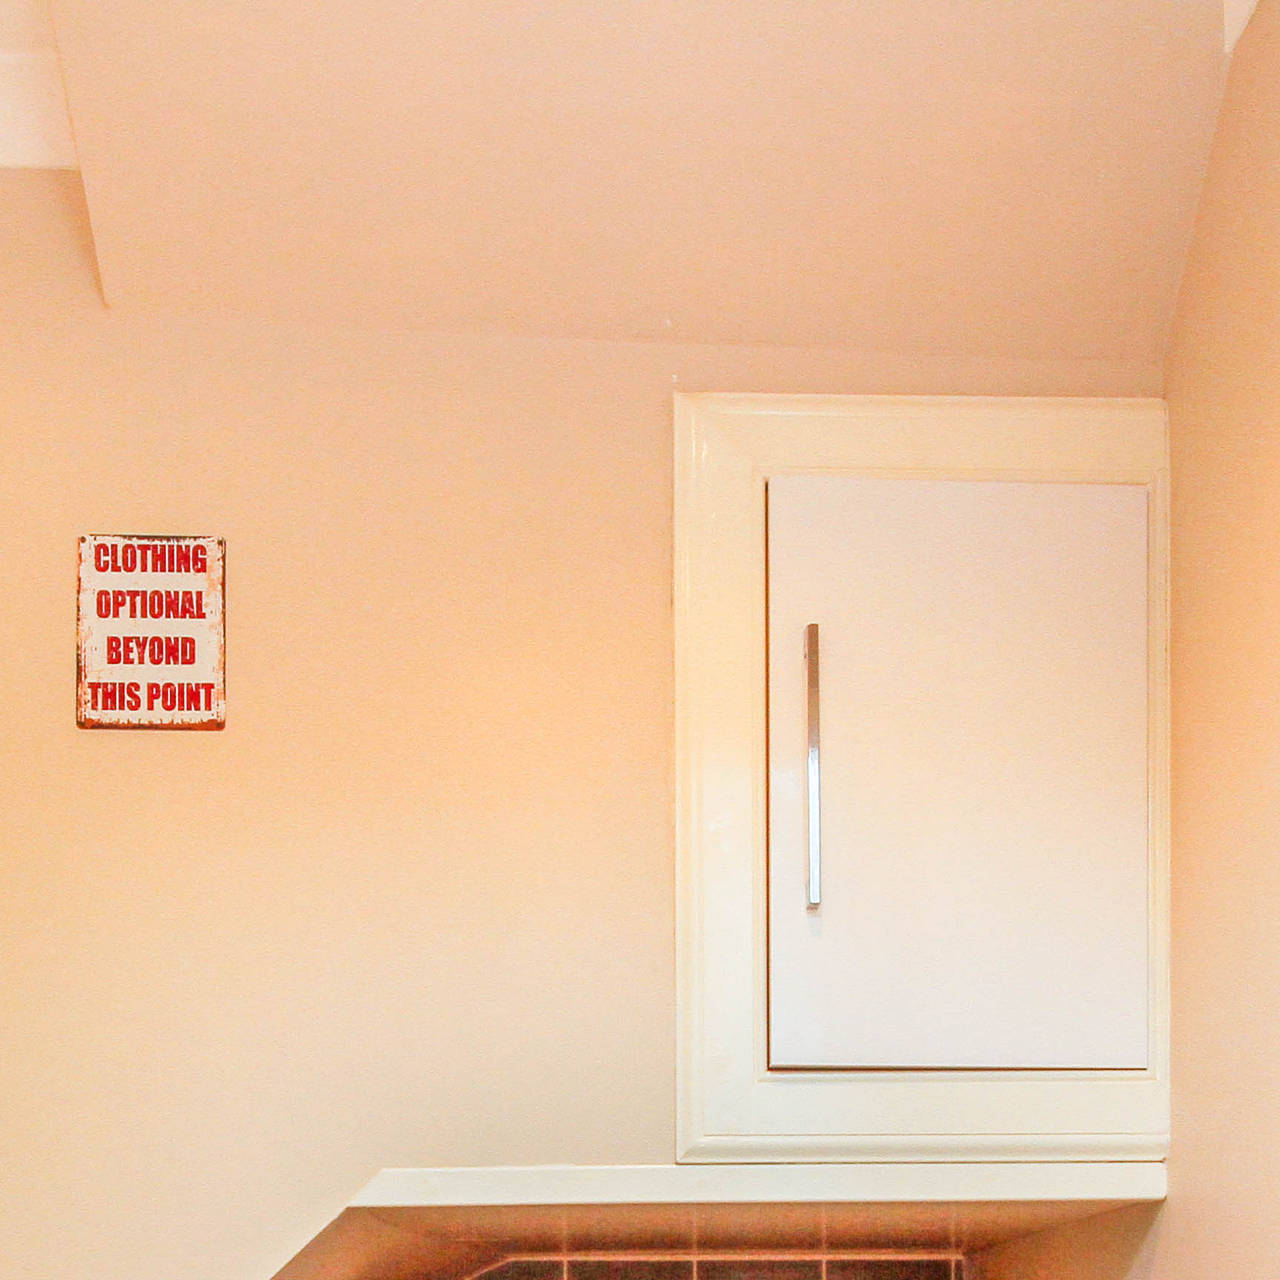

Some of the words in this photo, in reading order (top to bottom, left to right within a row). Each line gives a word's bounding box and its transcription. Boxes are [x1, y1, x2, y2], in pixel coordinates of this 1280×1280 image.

[94, 543, 207, 573] CLOTHING
[96, 589, 206, 619] OPTIONAL
[106, 636, 196, 665] BEYOND
[88, 682, 141, 711] THIS
[147, 682, 215, 711] POINT
